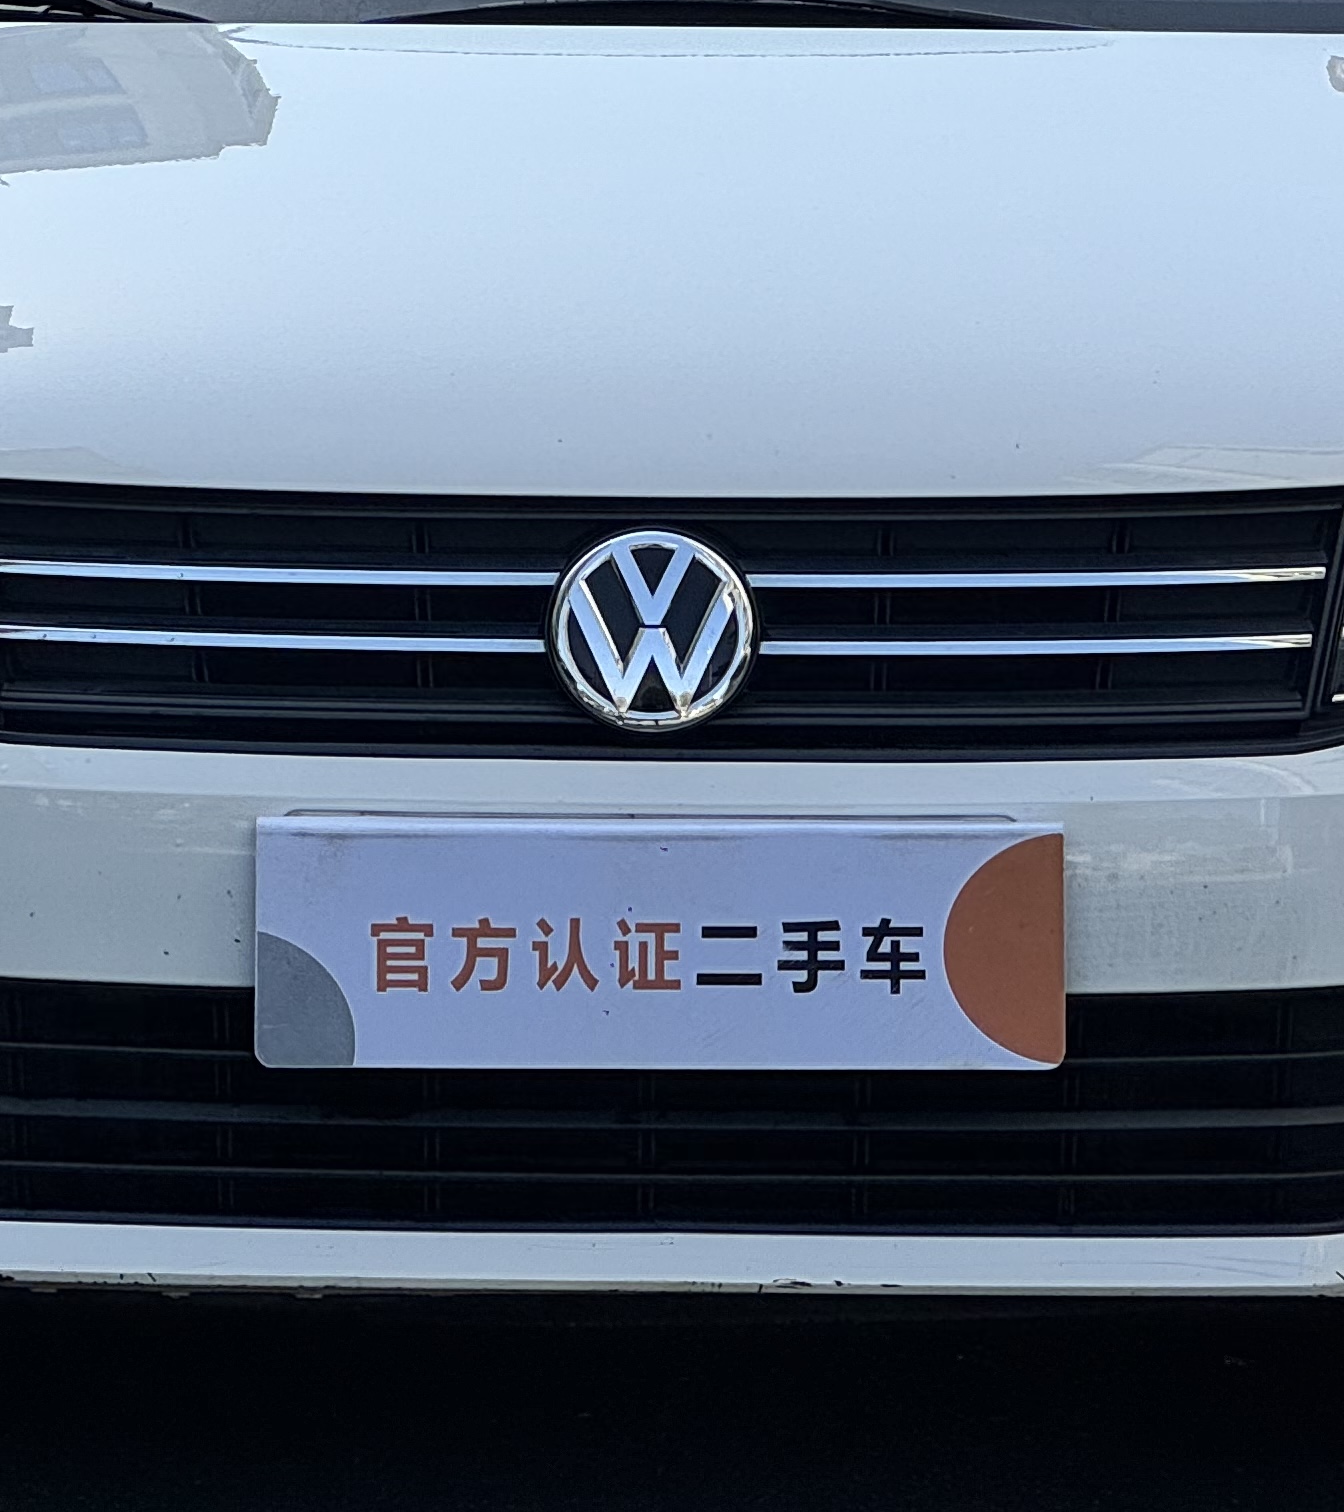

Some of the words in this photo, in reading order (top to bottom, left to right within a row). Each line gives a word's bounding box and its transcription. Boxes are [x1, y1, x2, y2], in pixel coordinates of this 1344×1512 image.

[369, 915, 927, 996] 官方认证二手车
